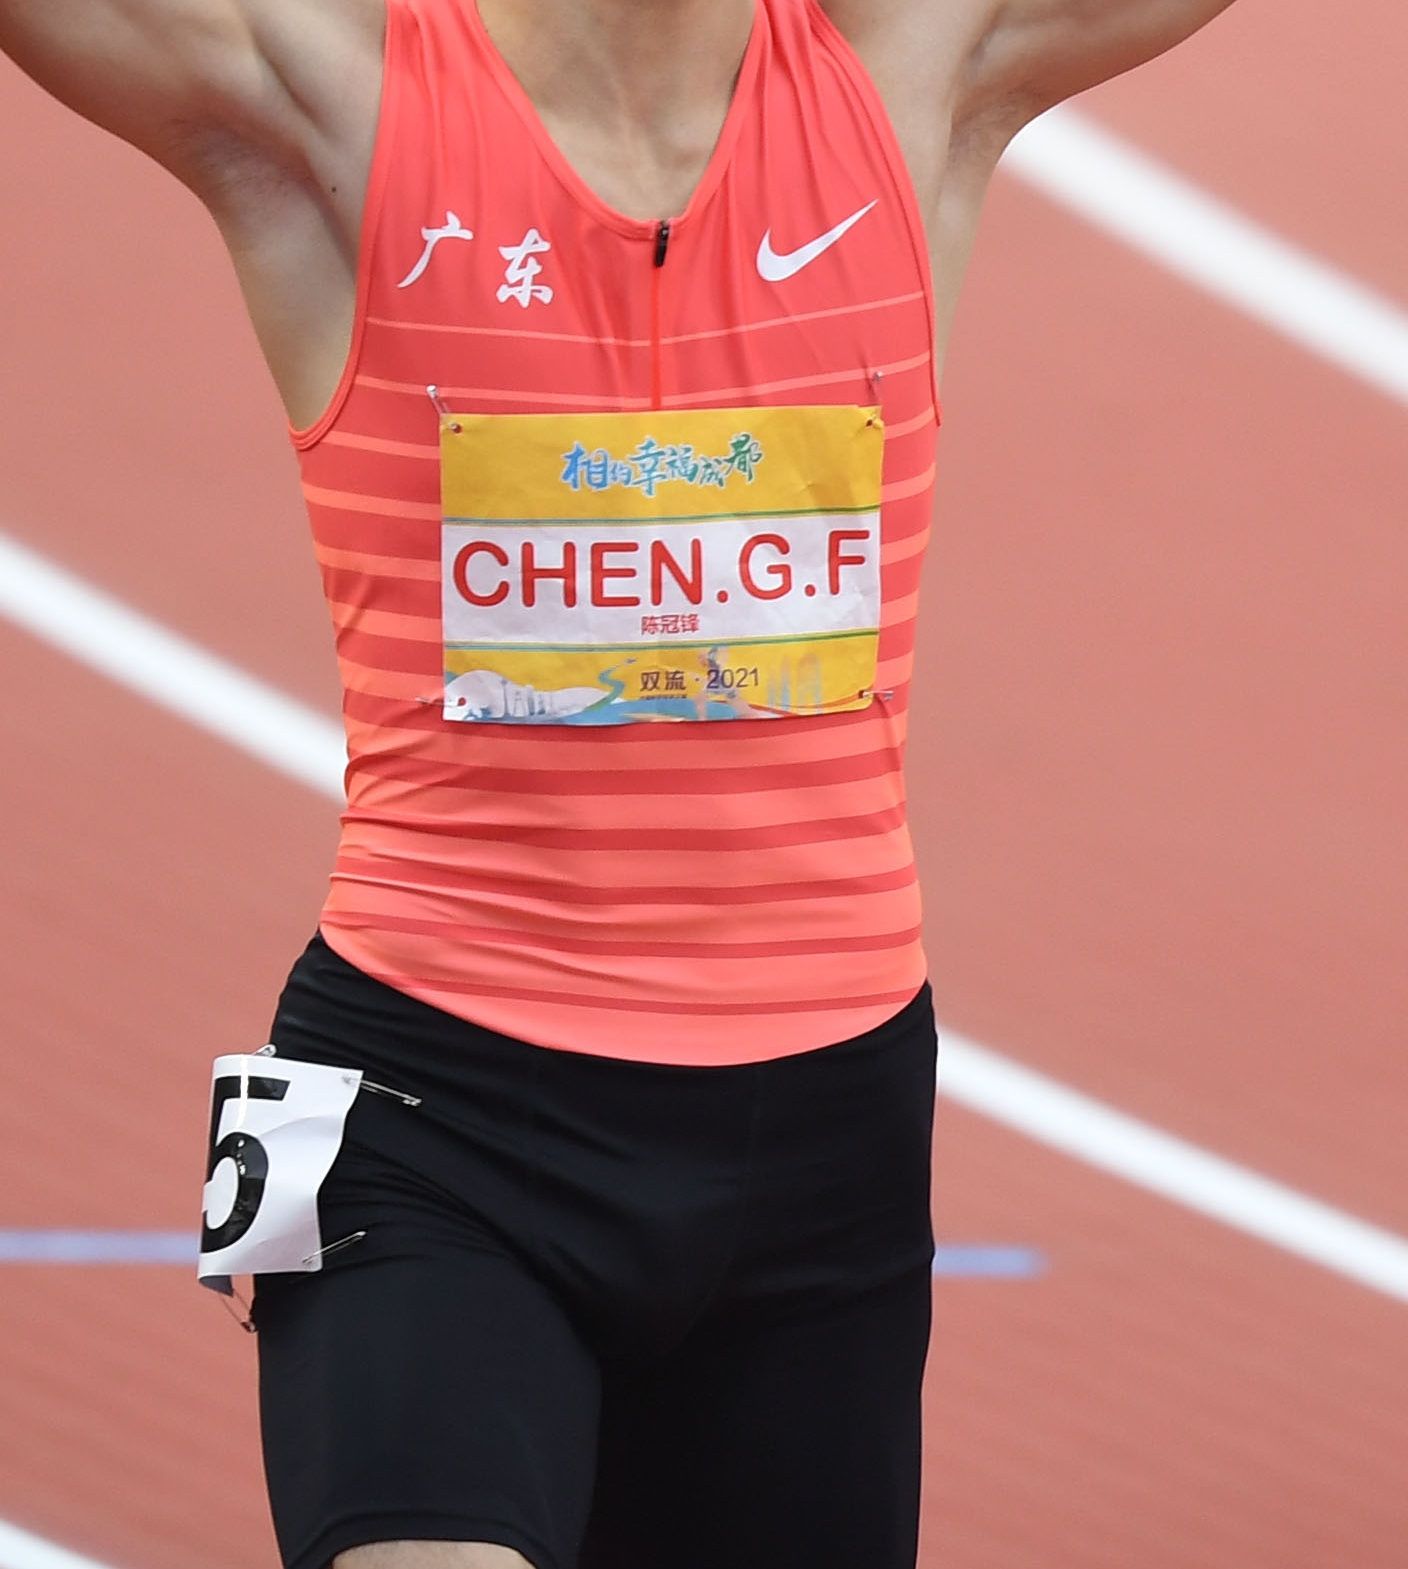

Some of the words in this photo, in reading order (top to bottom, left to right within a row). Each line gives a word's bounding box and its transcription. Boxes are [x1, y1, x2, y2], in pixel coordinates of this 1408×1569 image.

[397, 210, 554, 309] 广东
[560, 432, 763, 497] 相约幸福成都
[452, 529, 871, 609] CHEN.G.F
[640, 613, 700, 636] 陈冠锋
[199, 1074, 292, 1255] 5
